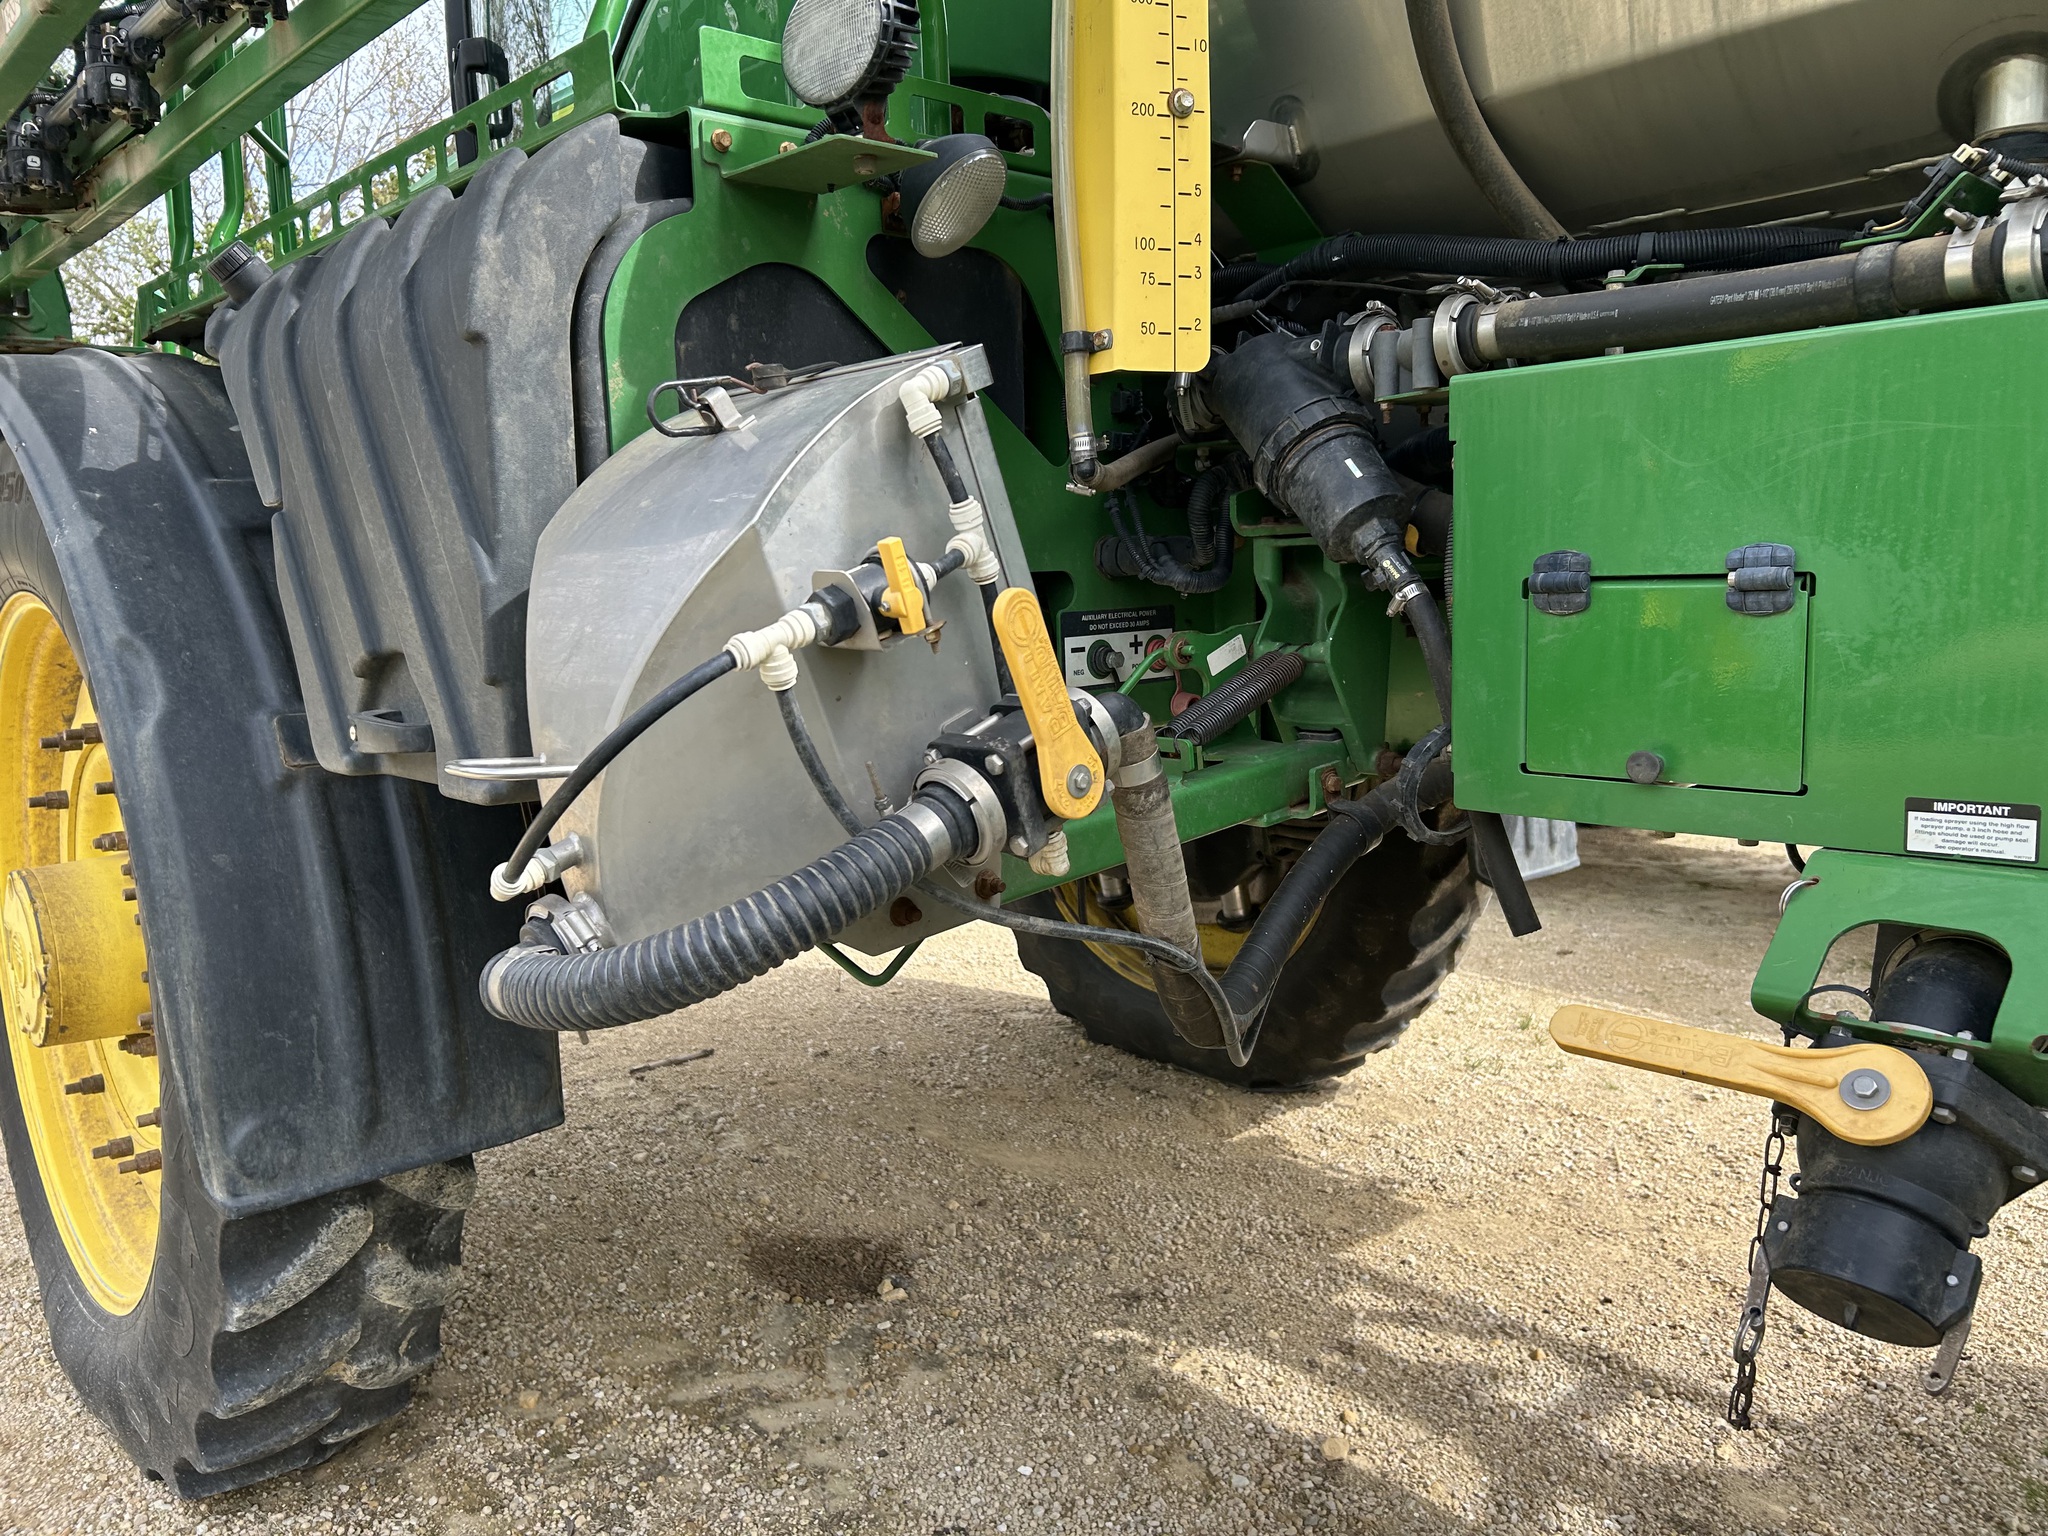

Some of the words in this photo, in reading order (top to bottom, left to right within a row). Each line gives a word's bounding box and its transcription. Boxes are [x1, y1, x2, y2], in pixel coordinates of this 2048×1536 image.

[1194, 39, 1207, 53] 10
[1131, 103, 1155, 117] 200
[1194, 184, 1202, 197] 5
[1133, 237, 1156, 251] 100
[1194, 233, 1202, 247] 4
[1140, 272, 1156, 286] 75
[1194, 266, 1202, 279] 3
[1140, 322, 1156, 336] 50
[1194, 318, 1202, 332] 2
[1081, 613, 1108, 622] AUXILIARY
[1108, 611, 1138, 620] ELECTRICAL
[1138, 609, 1157, 617] POWER
[1089, 623, 1097, 631] DO
[1109, 621, 1129, 629] EXCEED
[1136, 619, 1150, 627] AMPS
[1933, 801, 2011, 816] IMPORTANT
